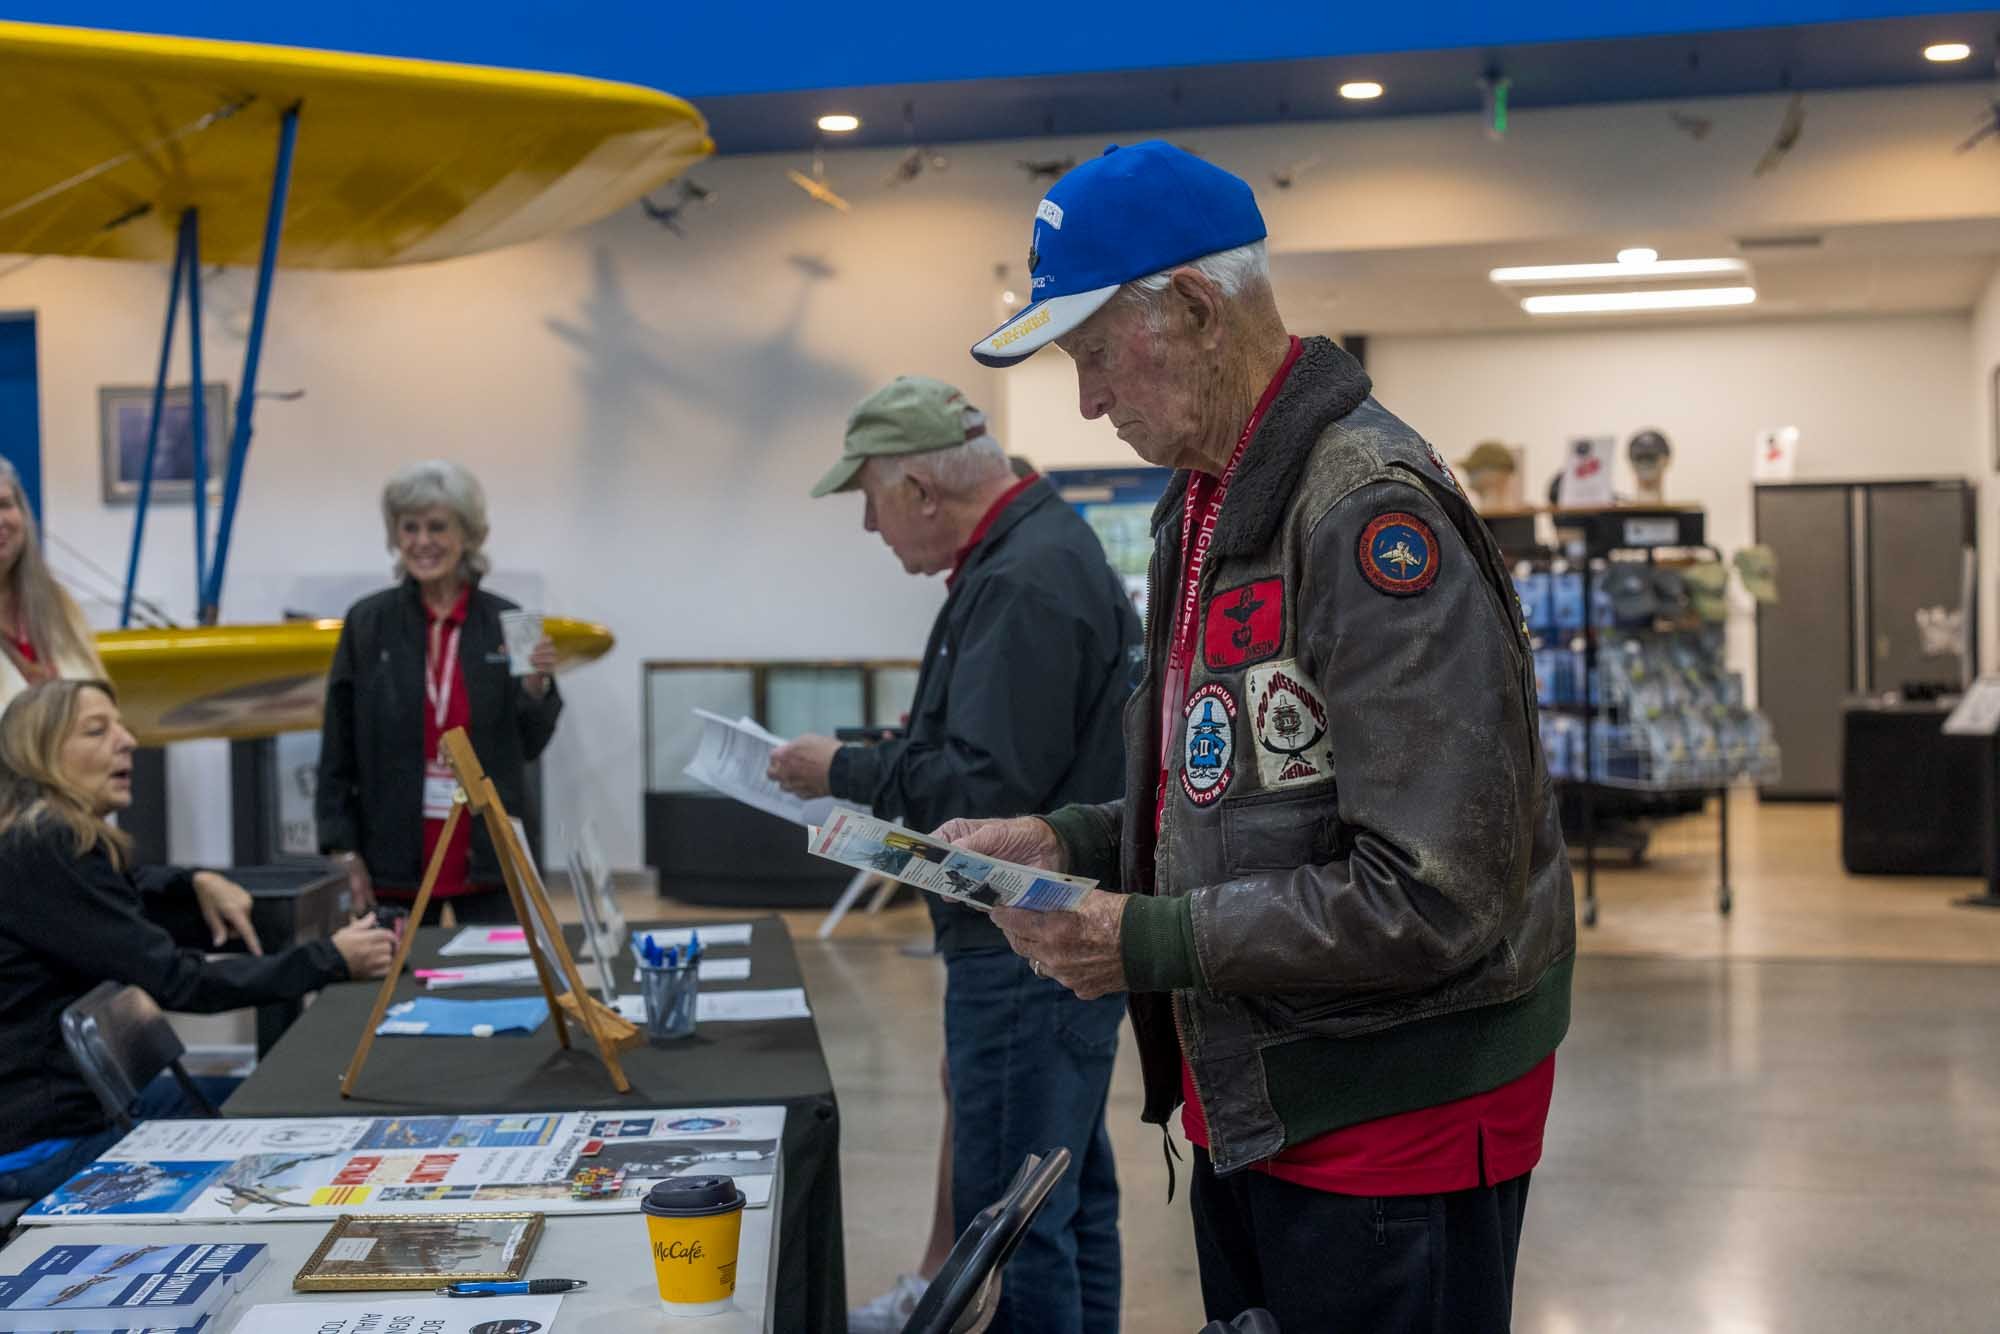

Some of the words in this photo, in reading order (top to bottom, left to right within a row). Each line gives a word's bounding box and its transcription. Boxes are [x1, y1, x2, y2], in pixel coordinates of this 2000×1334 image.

[1190, 502, 1223, 577] FLIGHT
[1209, 684, 1237, 717] HOURS
[1181, 774, 1222, 803] PHANTOM
